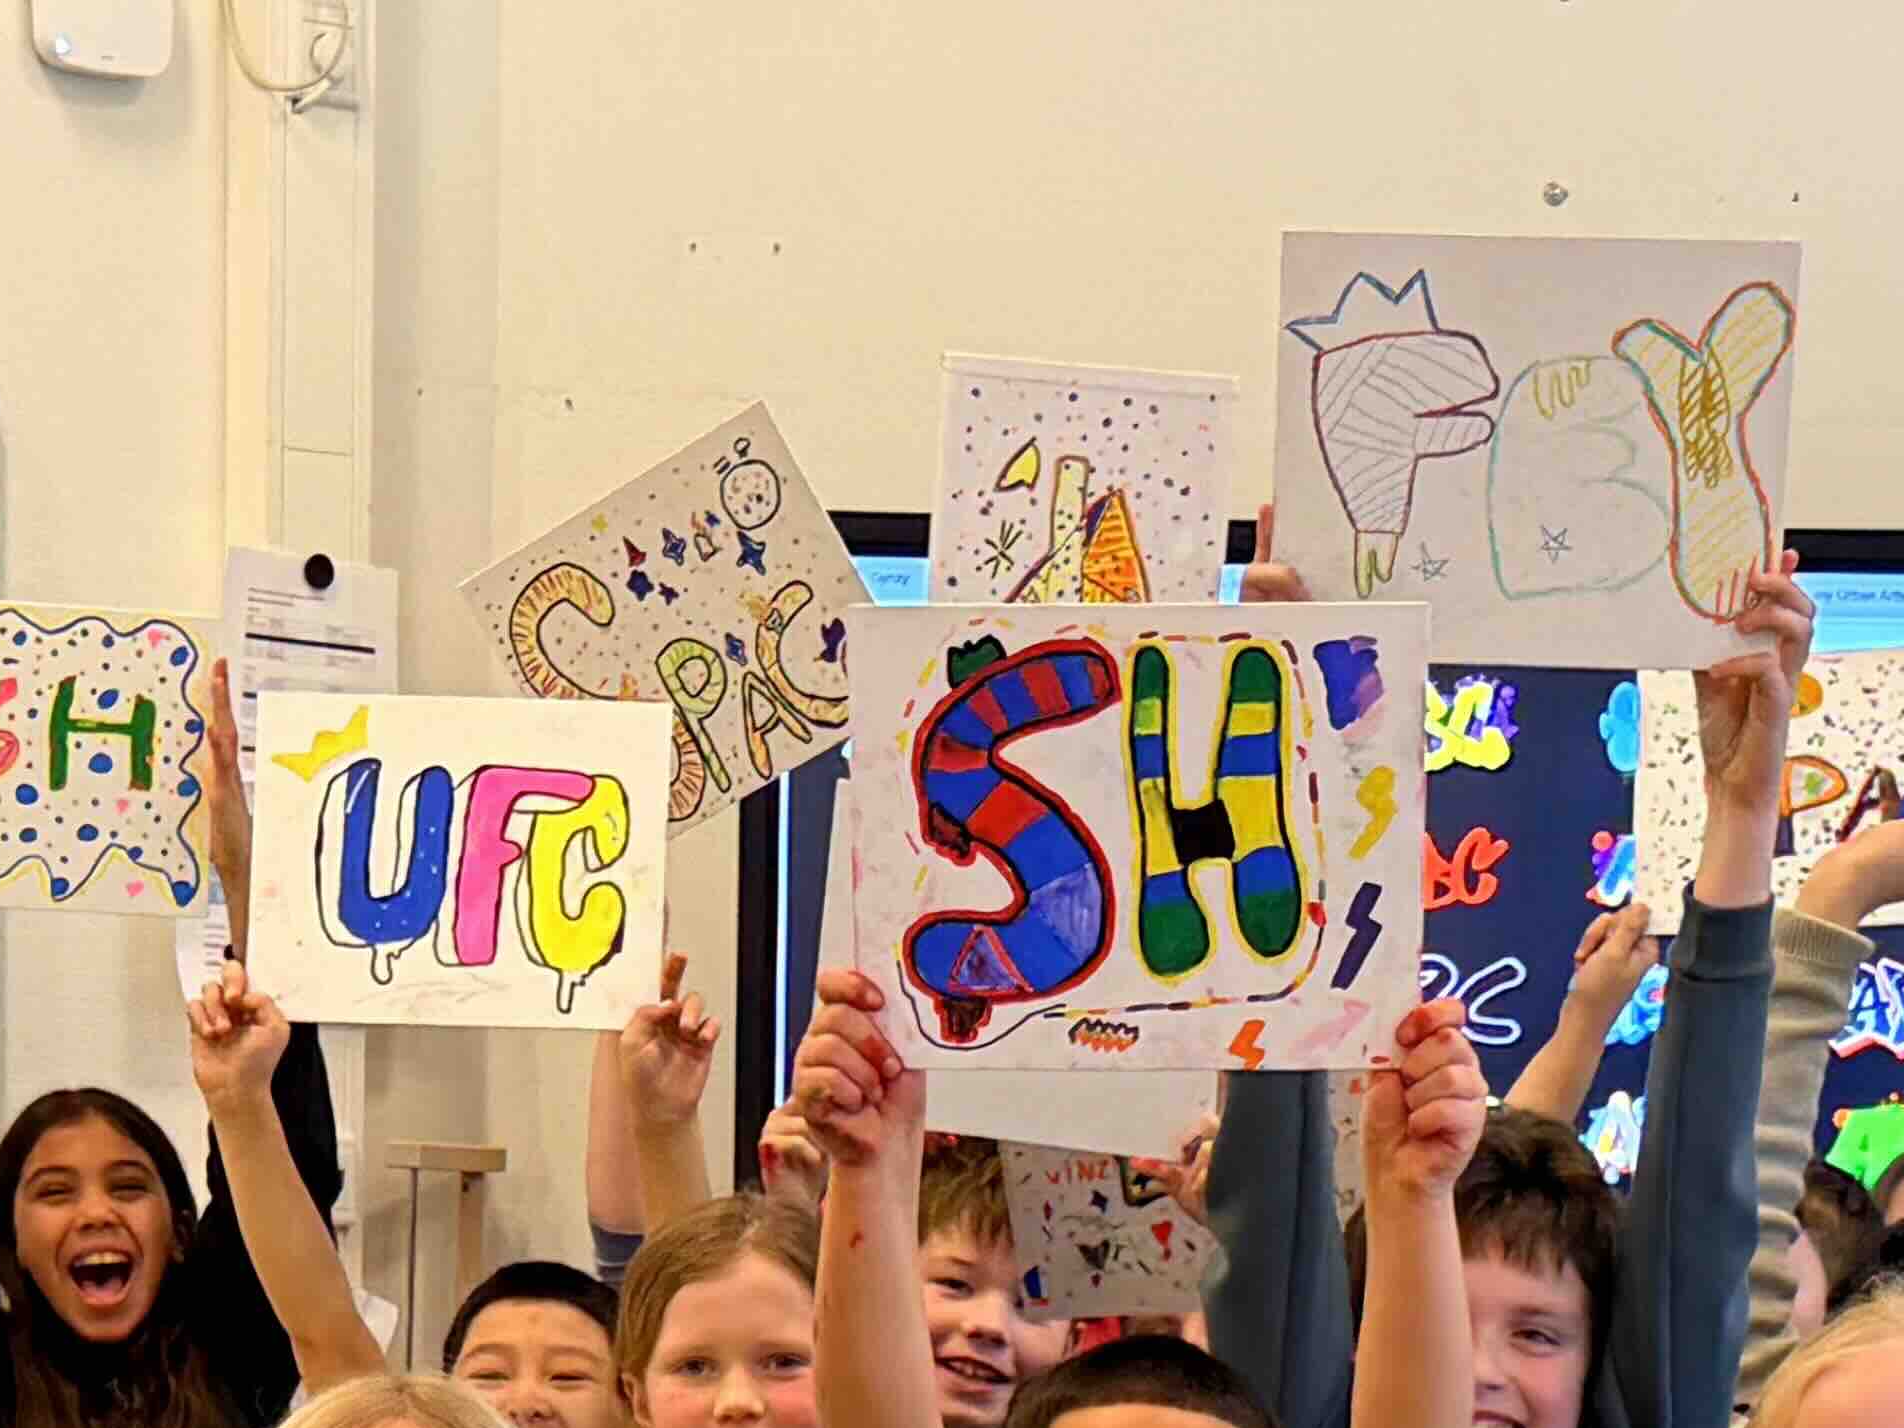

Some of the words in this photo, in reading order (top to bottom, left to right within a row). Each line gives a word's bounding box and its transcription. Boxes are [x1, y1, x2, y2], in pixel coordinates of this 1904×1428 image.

[509, 562, 849, 820] SPAC
[315, 758, 630, 985] UFC
[903, 637, 1304, 1004] SH
